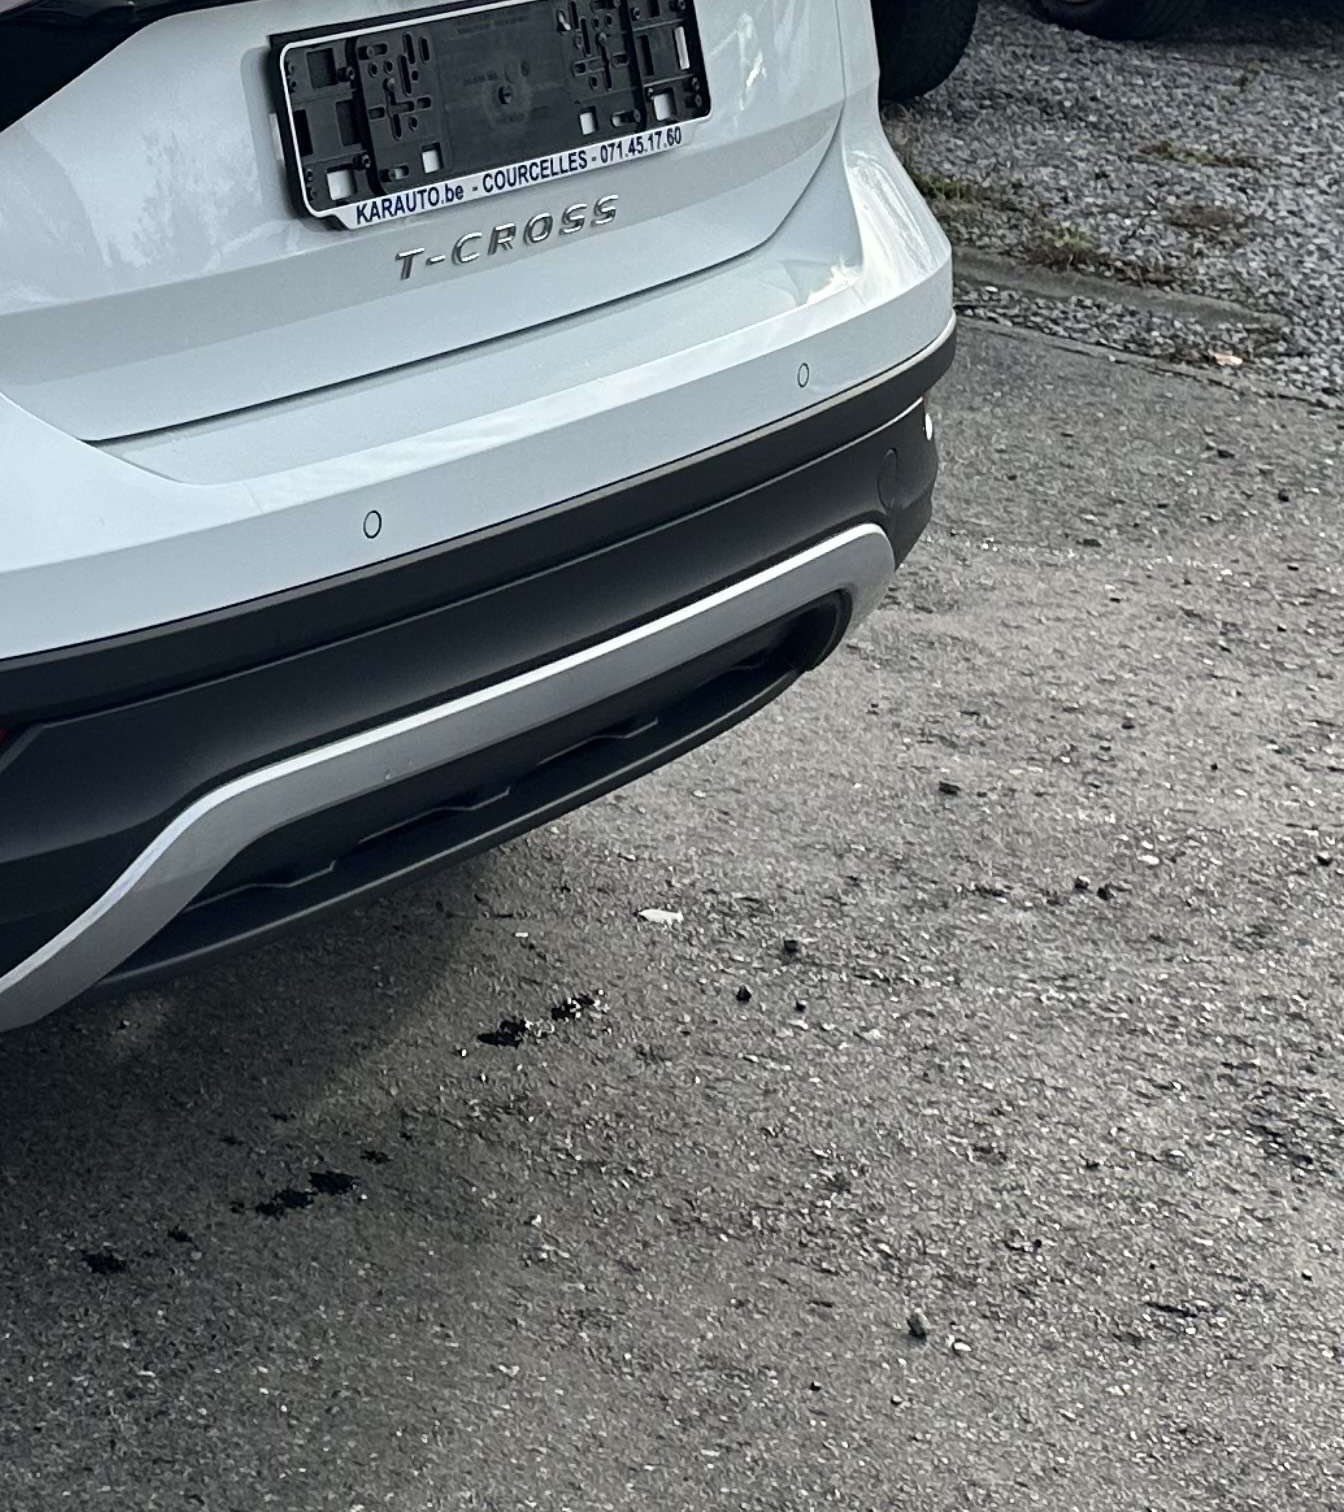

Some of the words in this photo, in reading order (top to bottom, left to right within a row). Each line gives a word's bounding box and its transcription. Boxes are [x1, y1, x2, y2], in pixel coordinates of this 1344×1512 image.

[355, 182, 465, 225] KARAUTO.be
[481, 149, 589, 194] COURCELLES
[599, 126, 683, 165] 071.45.17.60
[395, 194, 619, 280] T-CROSS
